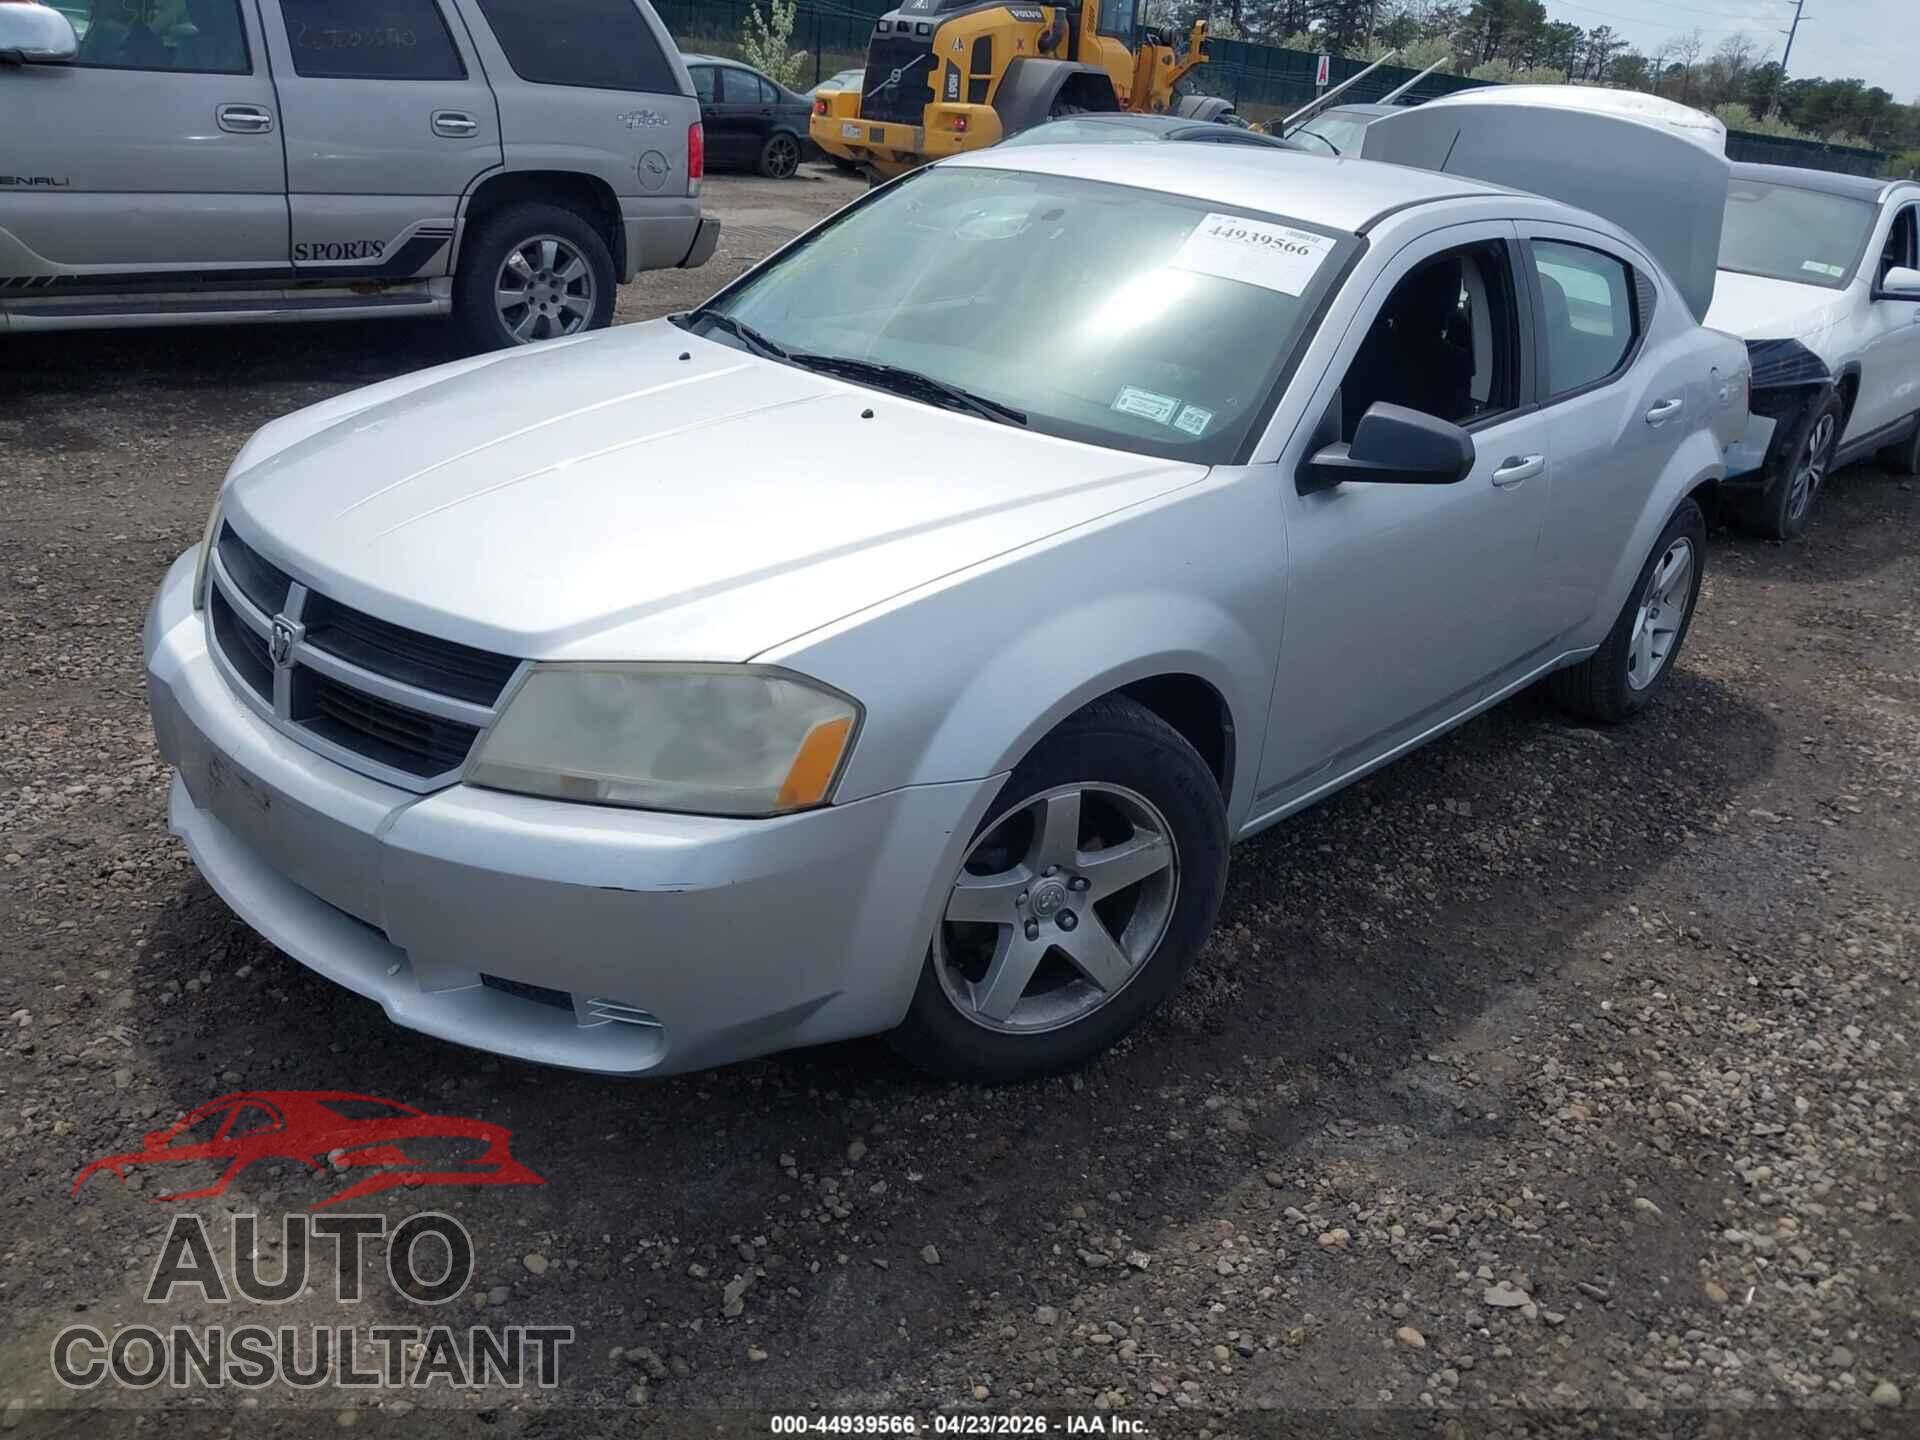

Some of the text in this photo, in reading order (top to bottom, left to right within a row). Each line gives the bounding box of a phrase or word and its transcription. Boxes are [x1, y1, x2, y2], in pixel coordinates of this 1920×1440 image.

[1011, 9, 1042, 18] VOLVO
[294, 240, 385, 260] SPORTS
[1207, 225, 1310, 256] 44939566
